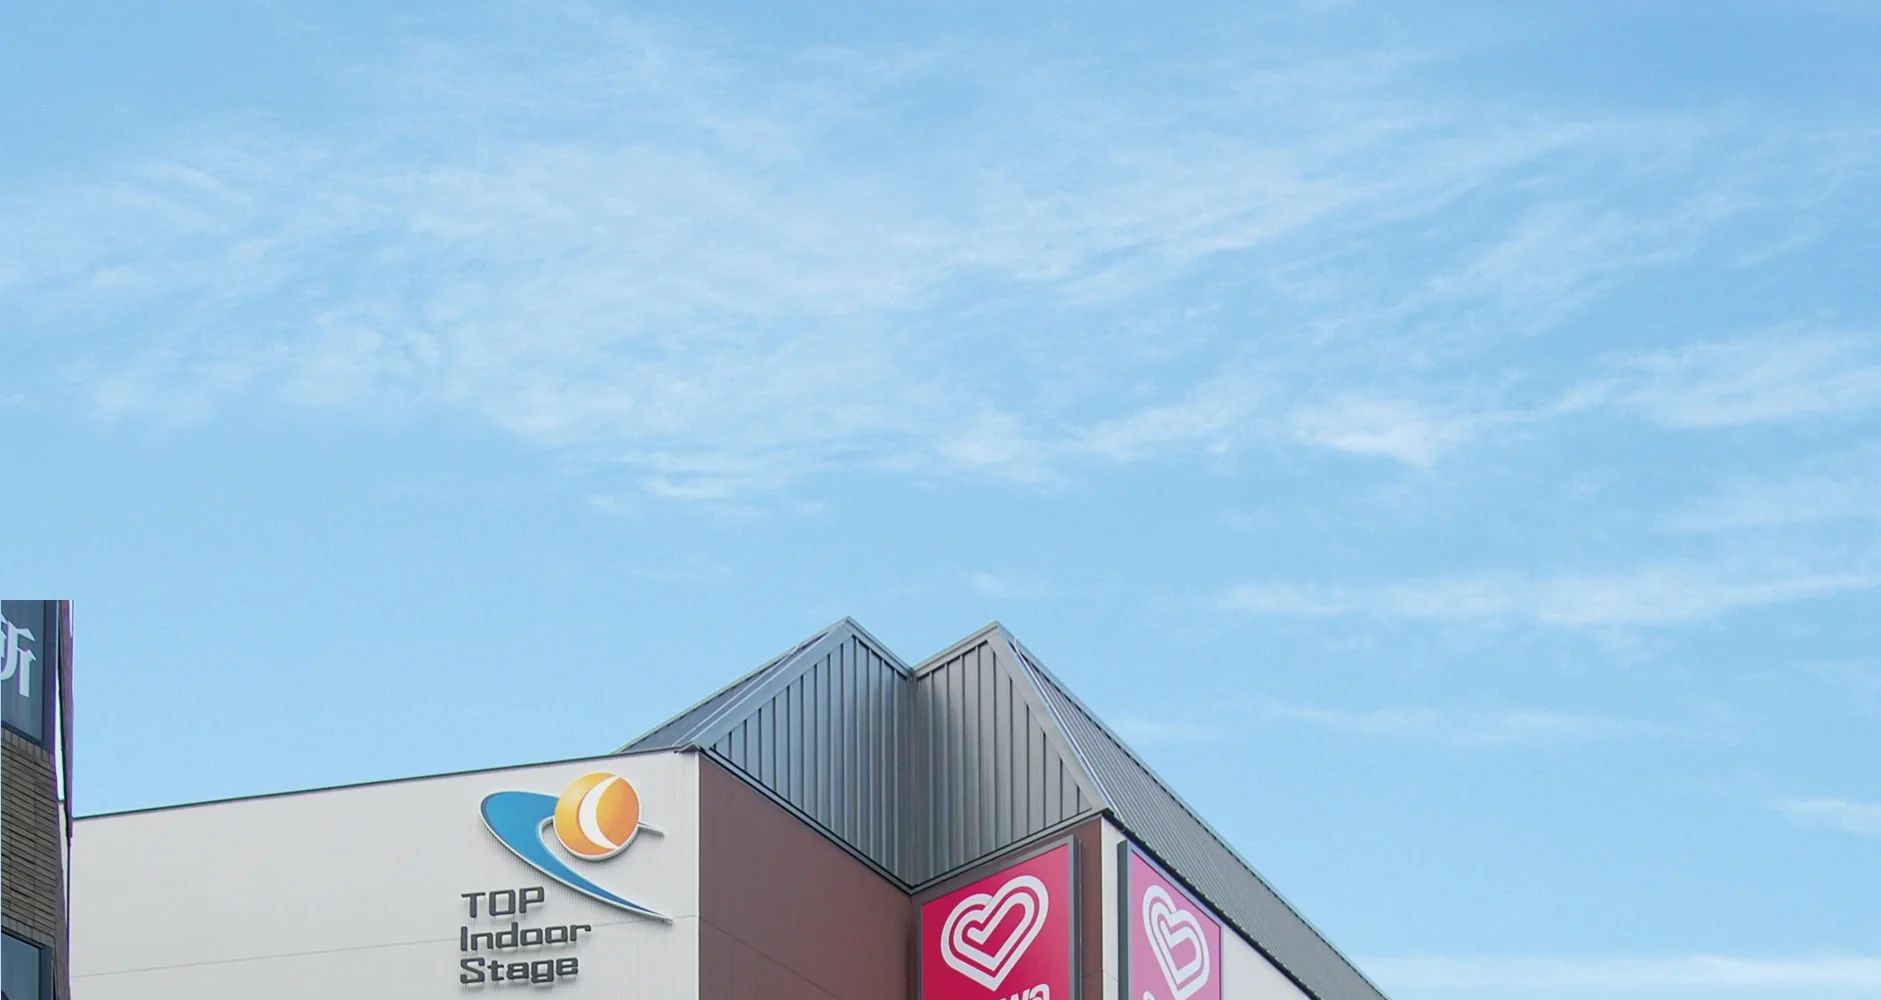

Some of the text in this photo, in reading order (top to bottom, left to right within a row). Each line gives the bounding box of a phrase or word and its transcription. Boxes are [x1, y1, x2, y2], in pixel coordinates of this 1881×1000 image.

[461, 886, 545, 919] TOP
[460, 921, 592, 952] Indoor
[460, 957, 579, 984] Stage
